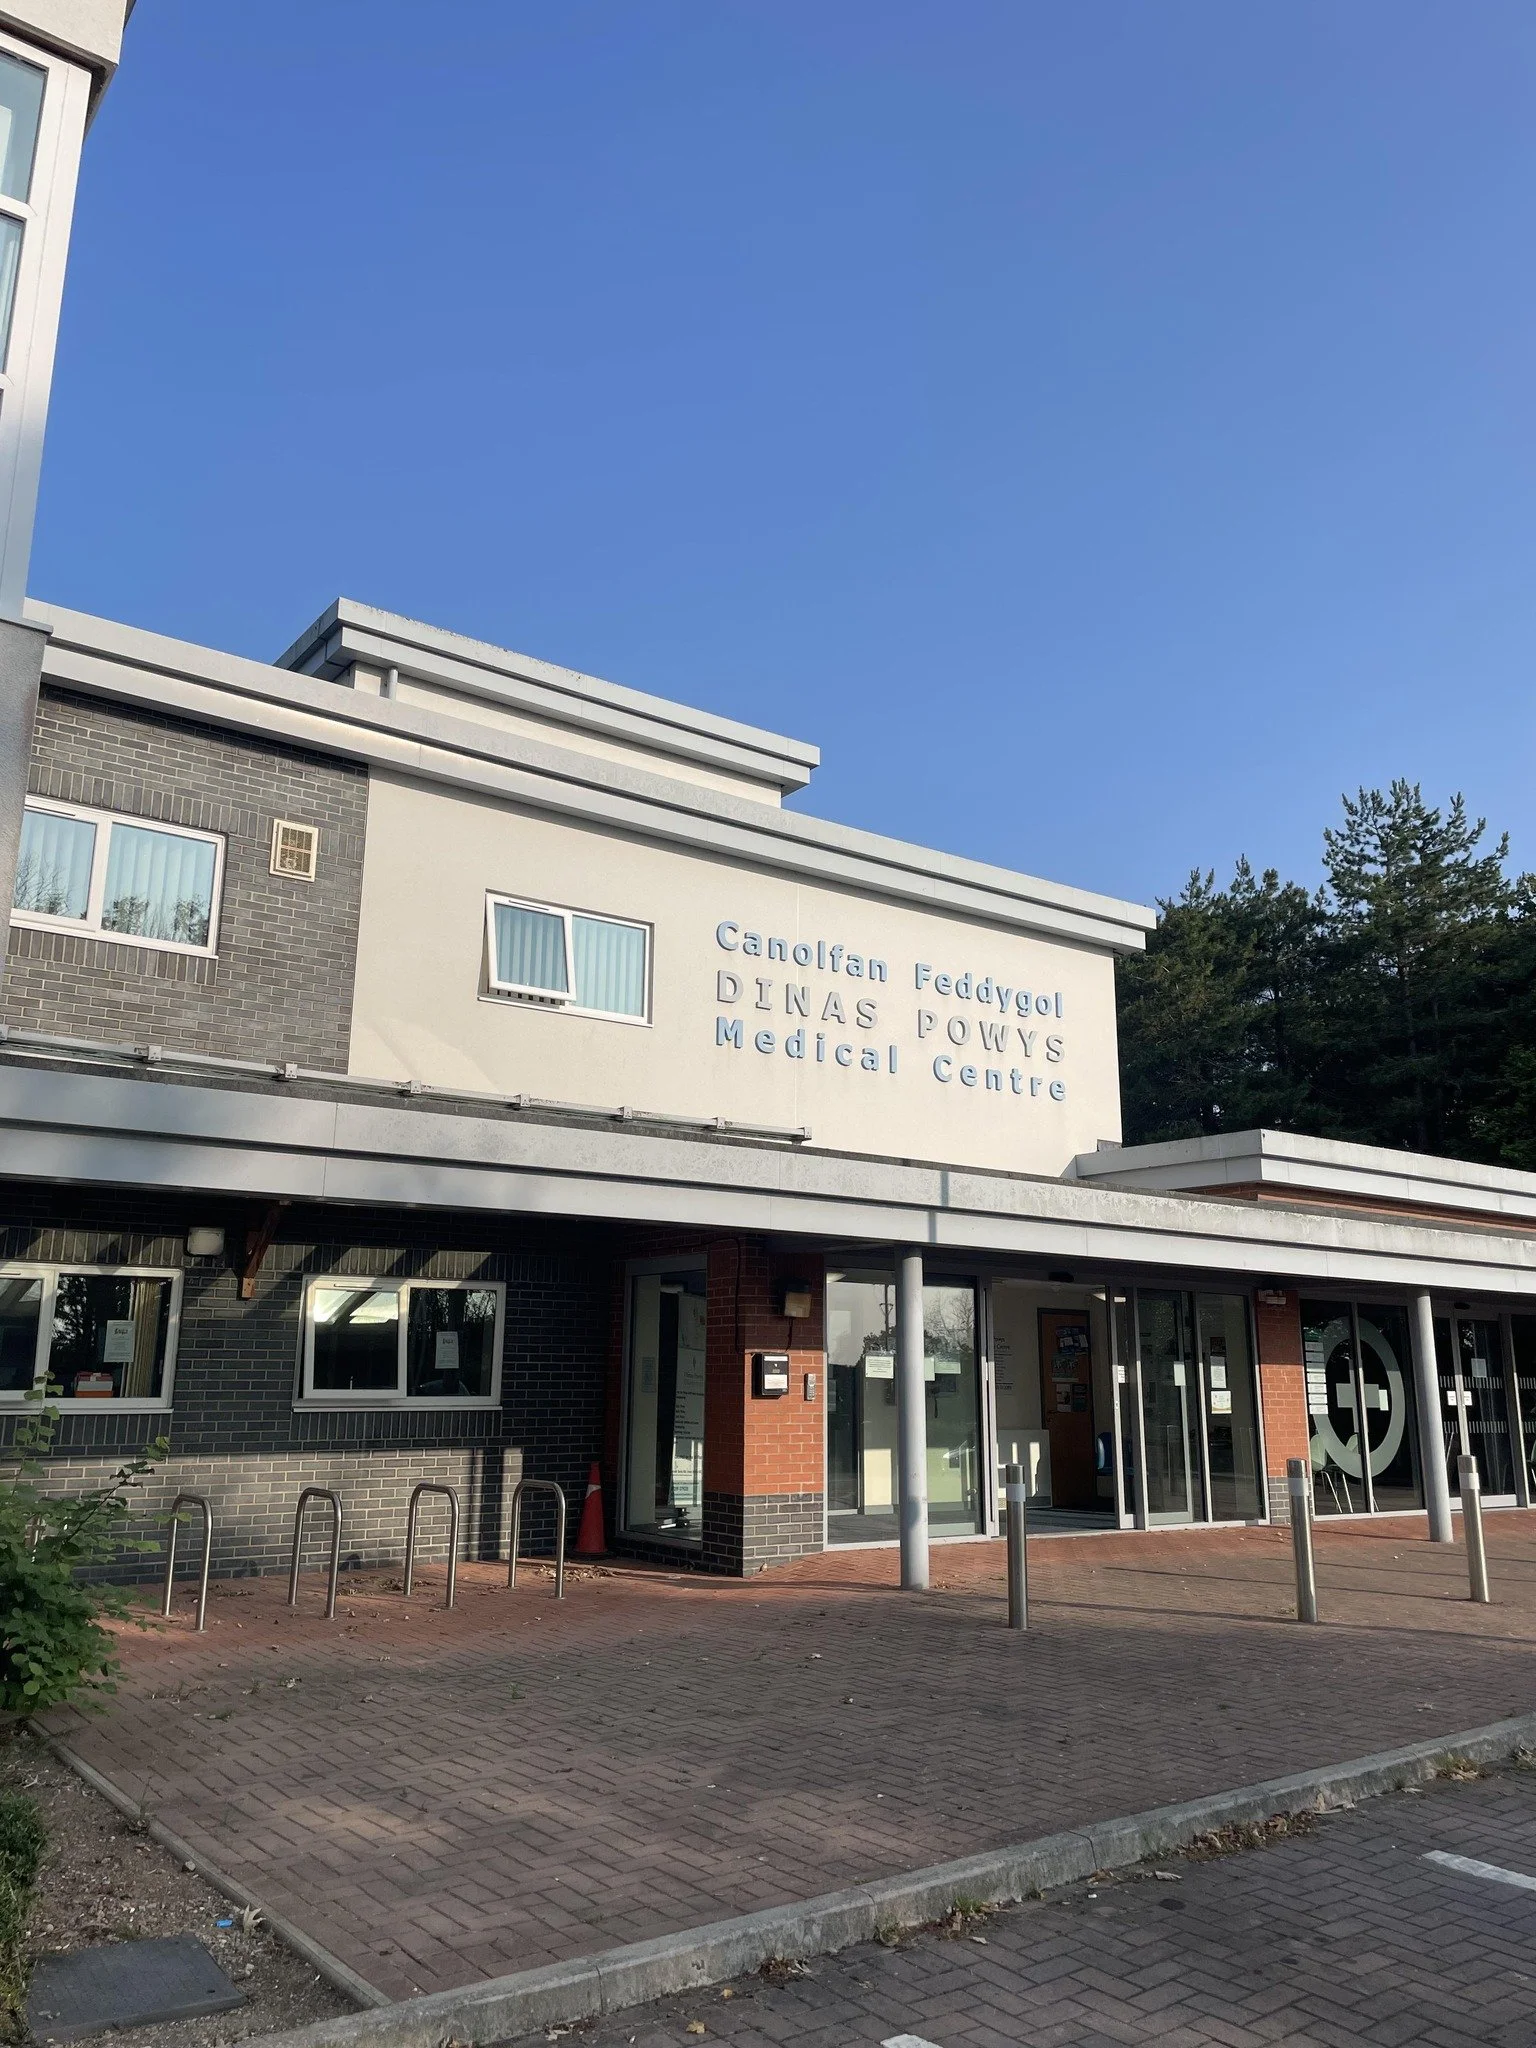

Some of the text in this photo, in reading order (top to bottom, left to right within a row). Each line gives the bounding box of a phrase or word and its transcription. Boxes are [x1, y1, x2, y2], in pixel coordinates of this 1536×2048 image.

[716, 920, 1064, 1018] Canolfan Feddygol
[716, 969, 1066, 1063] DINAS POWYS
[716, 1015, 1067, 1101] Medical Centre
